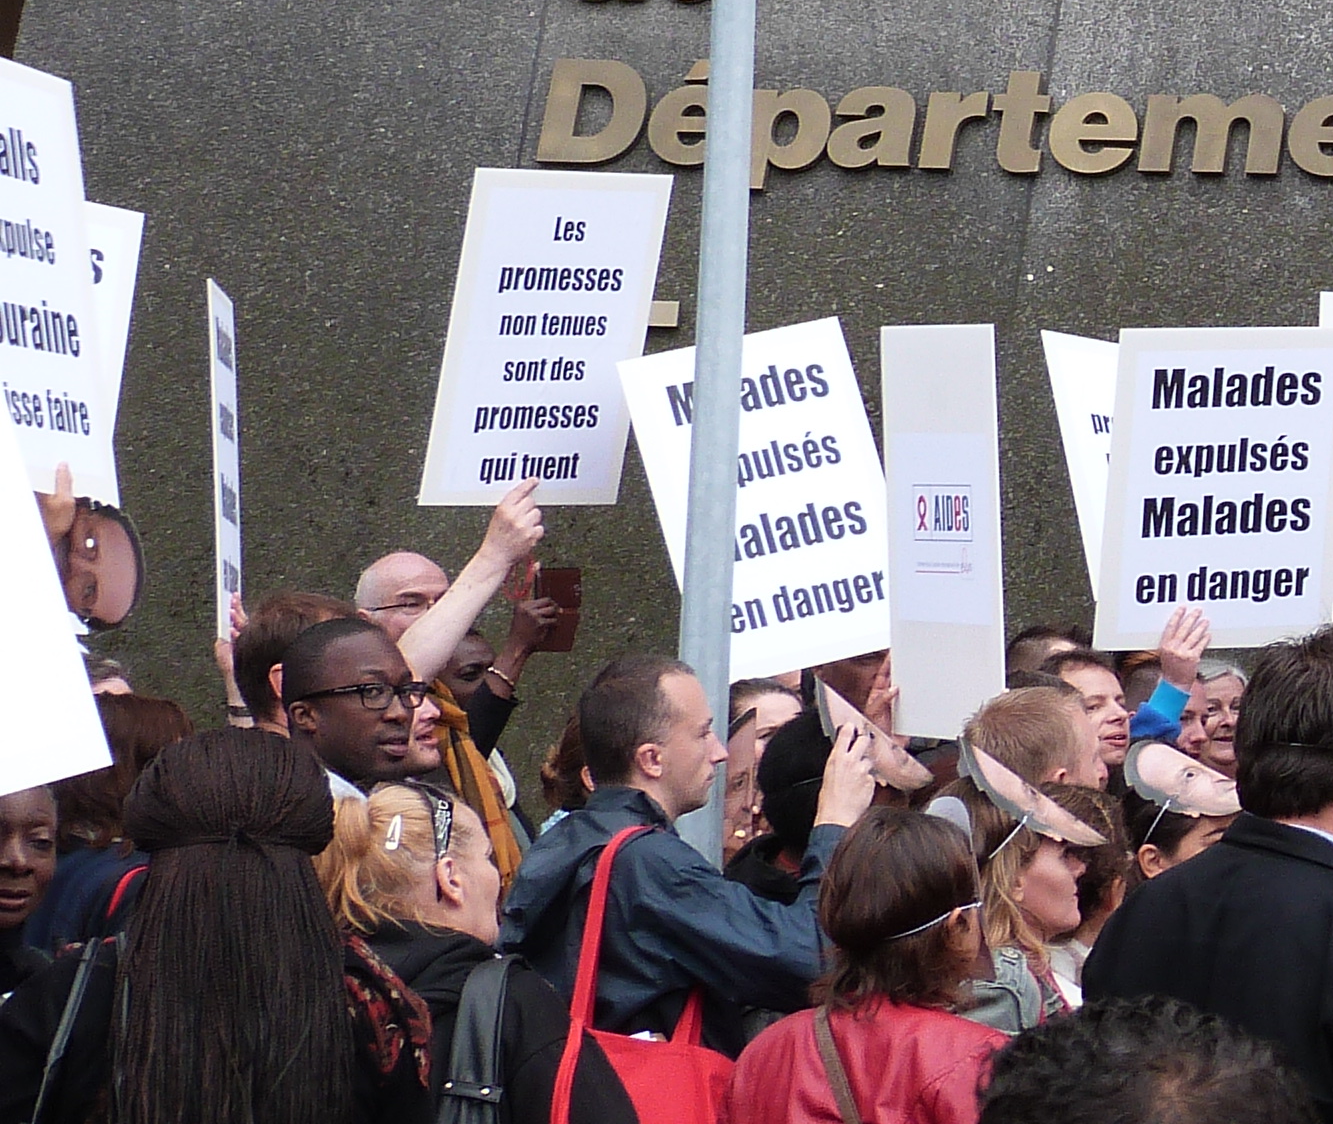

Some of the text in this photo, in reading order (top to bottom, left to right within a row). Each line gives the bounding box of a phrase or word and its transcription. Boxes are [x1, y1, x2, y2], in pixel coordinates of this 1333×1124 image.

[554, 217, 586, 243] Les
[499, 265, 623, 293] promesses
[499, 312, 606, 338] non tenues
[504, 356, 585, 383] sont des
[1152, 366, 1322, 410] Malades
[47, 389, 90, 436] faire
[666, 364, 829, 426] Mades
[475, 401, 598, 433] promesses
[480, 452, 578, 484] qui tuent
[737, 431, 841, 488] pulsés
[1153, 436, 1309, 478] expulsés
[734, 501, 867, 562] alades
[1141, 493, 1311, 538] Malades
[730, 570, 885, 633] en danger
[1136, 566, 1309, 604] en danger
